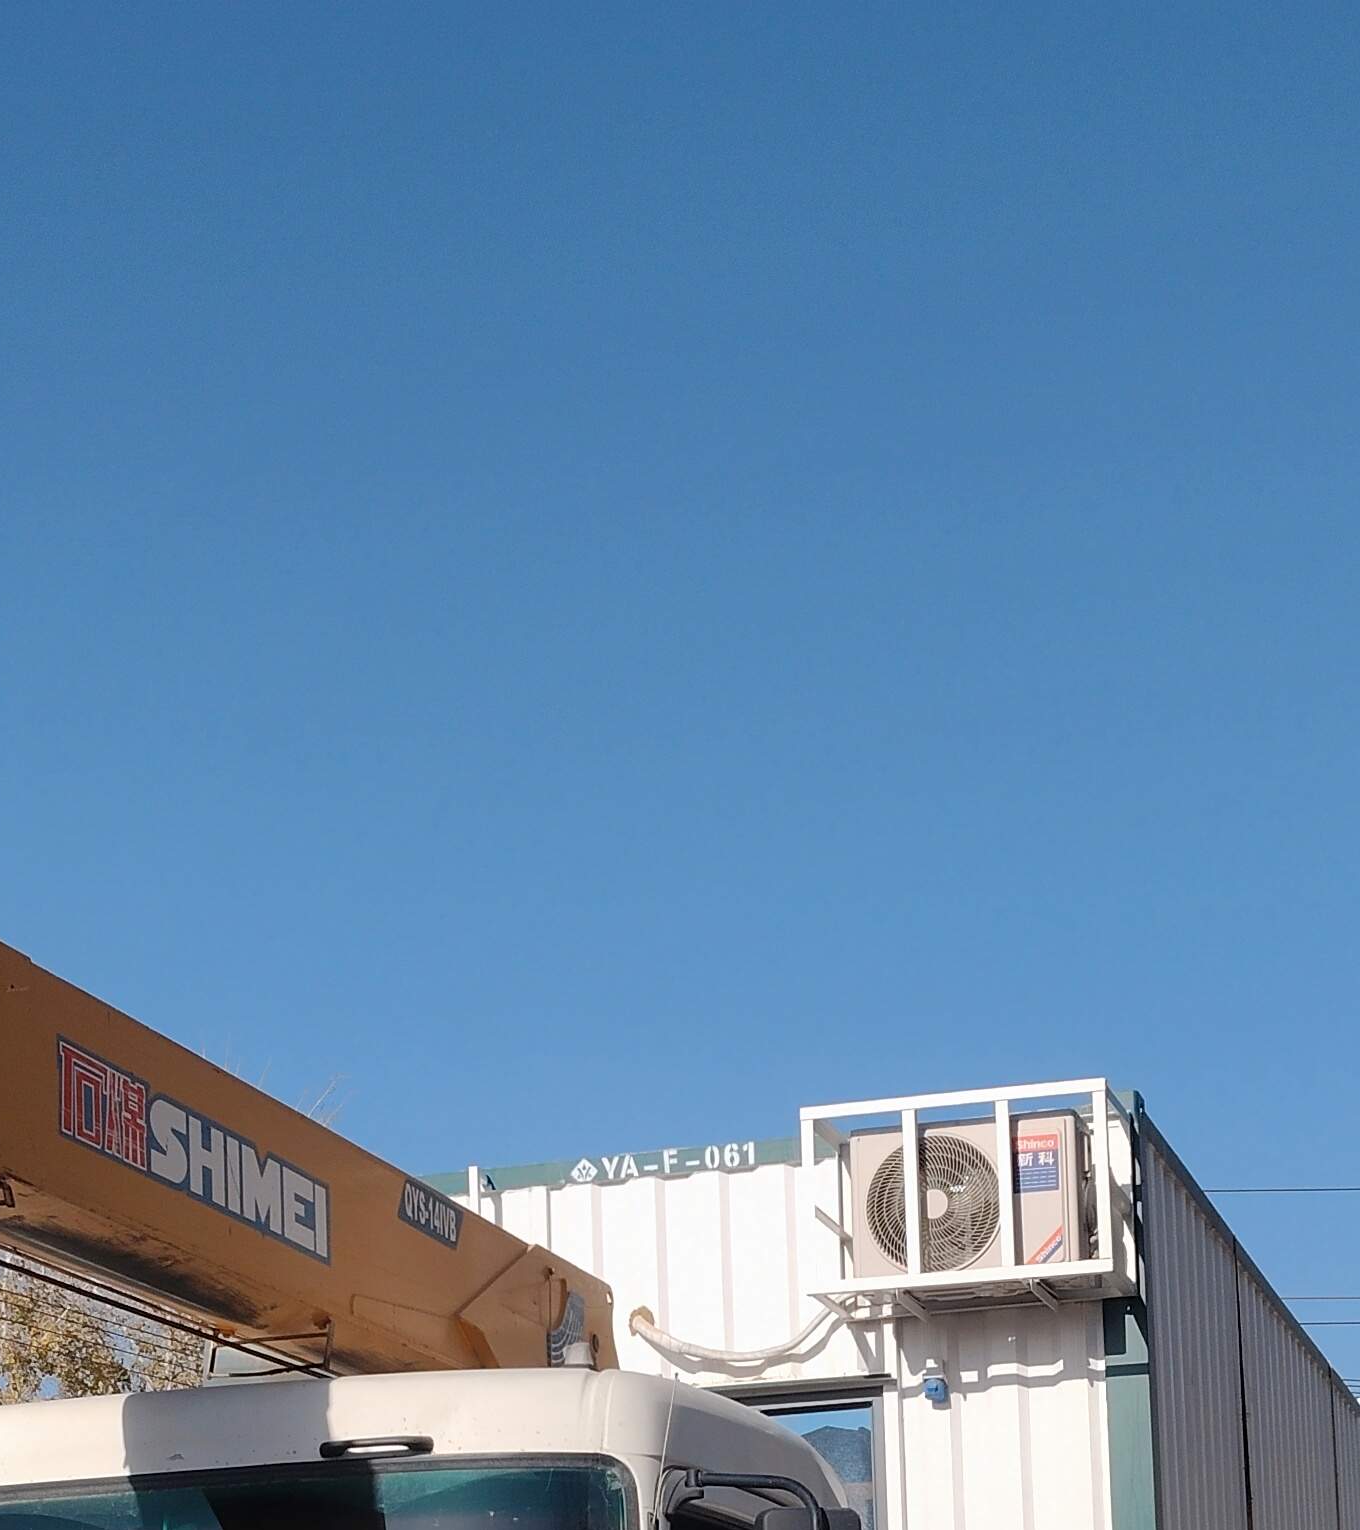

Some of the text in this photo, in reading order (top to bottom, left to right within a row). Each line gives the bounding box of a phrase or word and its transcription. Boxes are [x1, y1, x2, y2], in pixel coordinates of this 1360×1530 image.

[1016, 1138, 1055, 1150] Shinco
[602, 1141, 756, 1180] YA-F-061
[1018, 1151, 1055, 1167] 新科
[150, 1100, 329, 1258] SHIMEI
